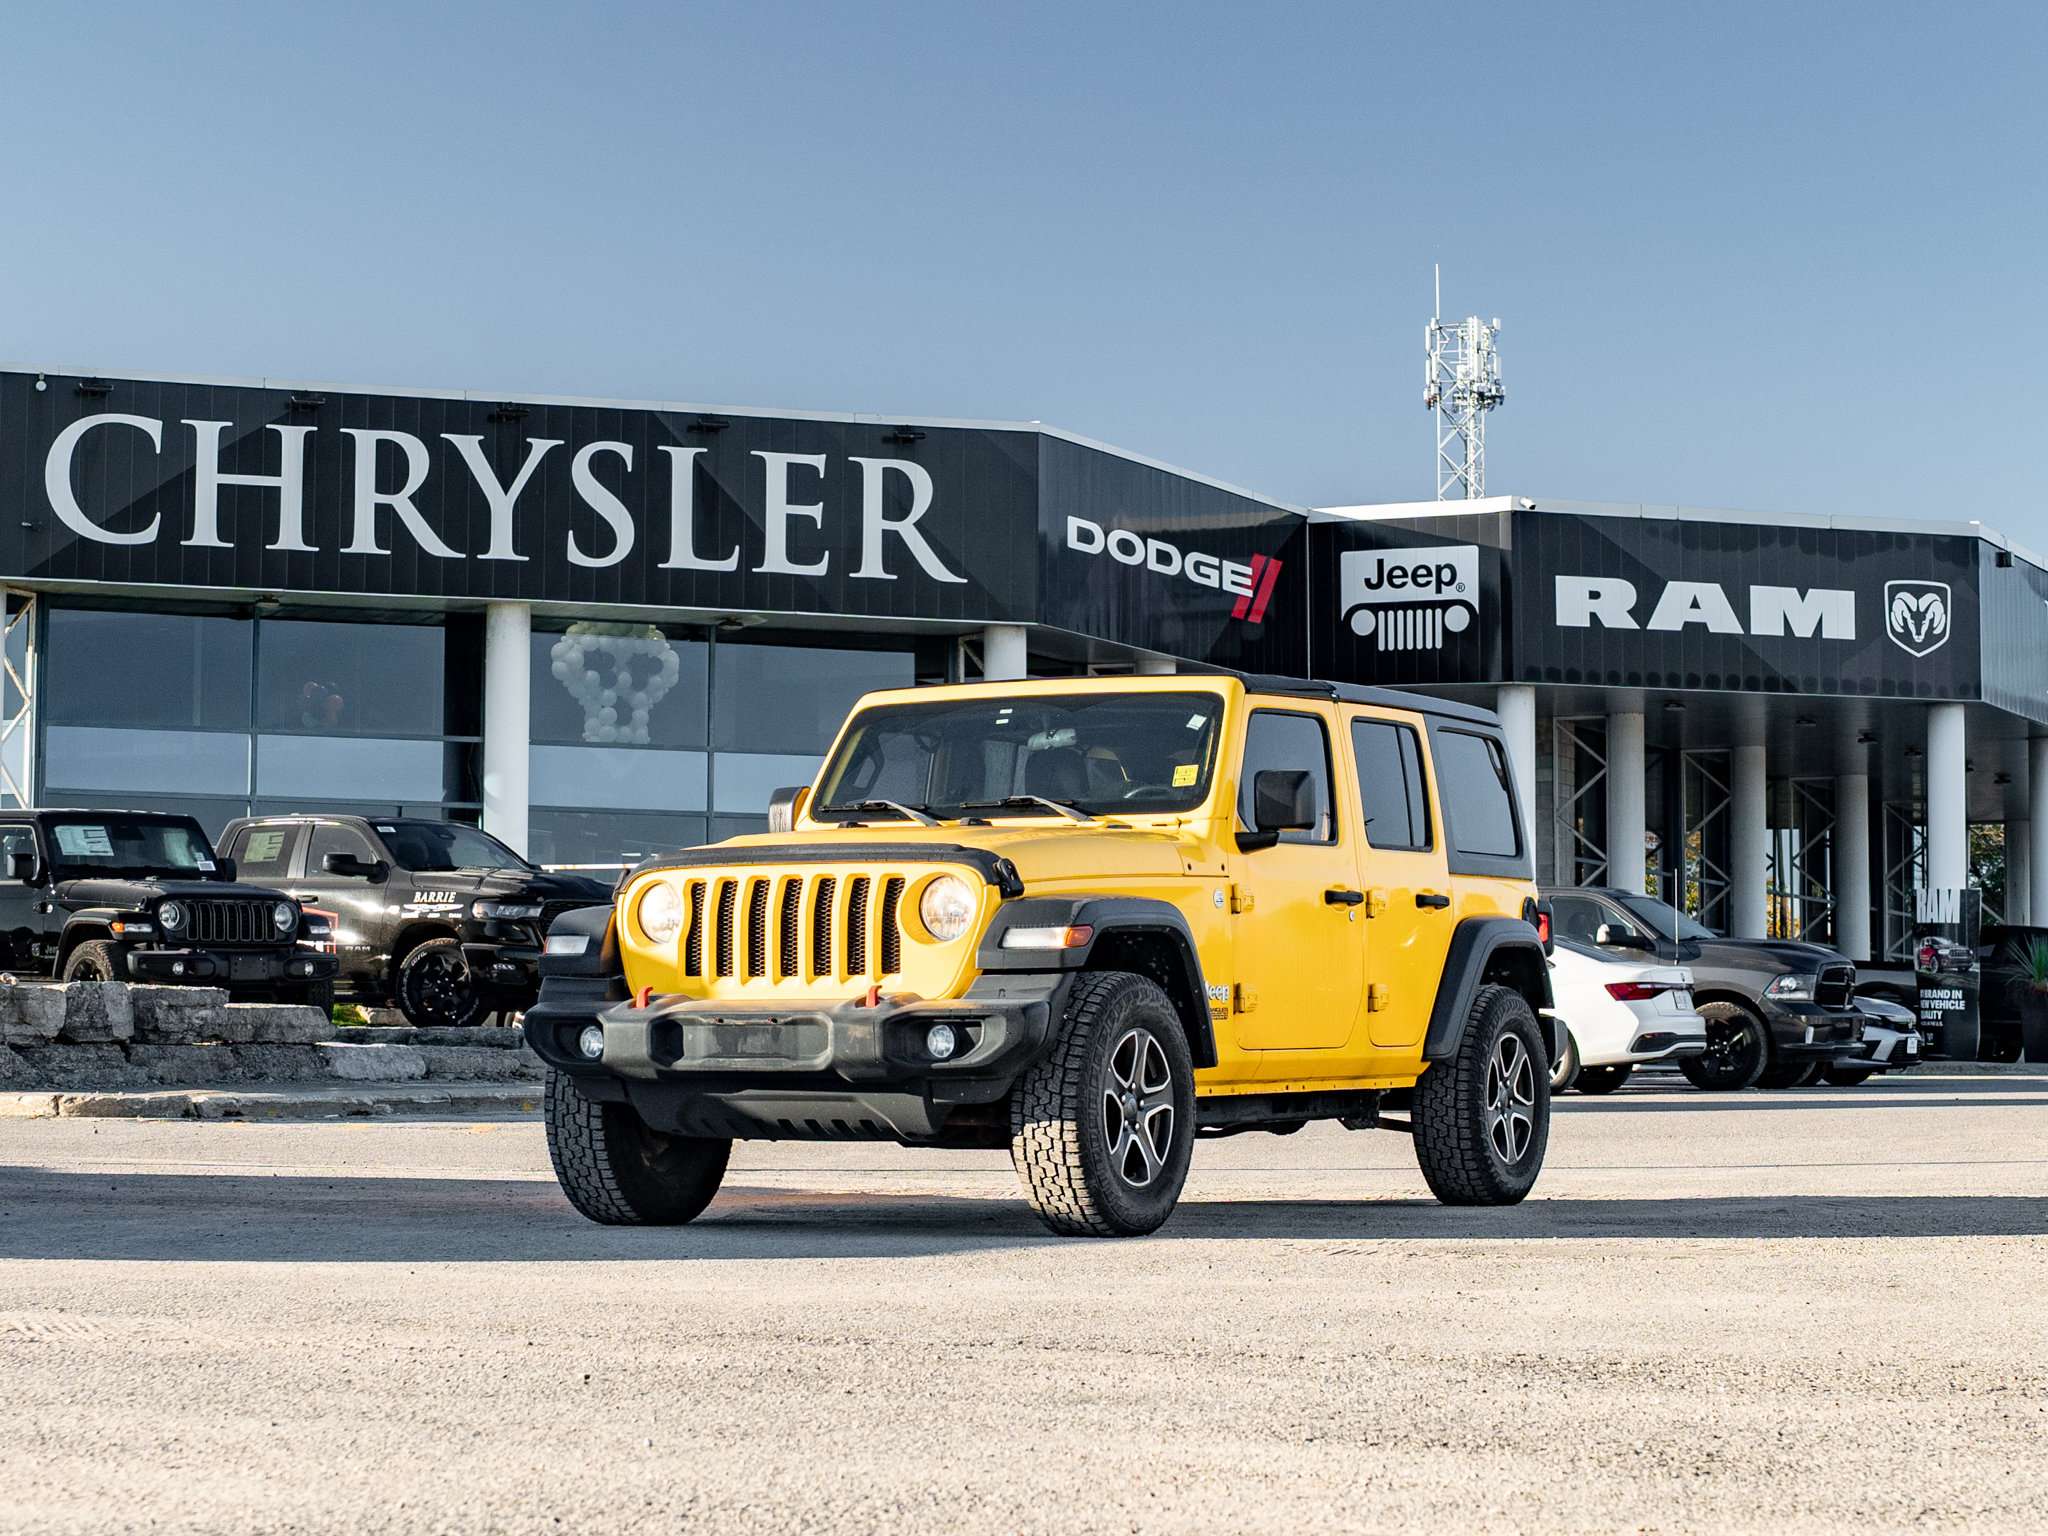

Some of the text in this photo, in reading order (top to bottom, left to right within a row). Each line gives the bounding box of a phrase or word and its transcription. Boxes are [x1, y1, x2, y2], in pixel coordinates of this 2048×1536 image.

[44, 412, 969, 585] CHRYSLER
[1066, 515, 1254, 598] DODGE
[1364, 558, 1457, 594] Jeep
[1555, 574, 1856, 641] RAM
[413, 891, 457, 903] BARRIE
